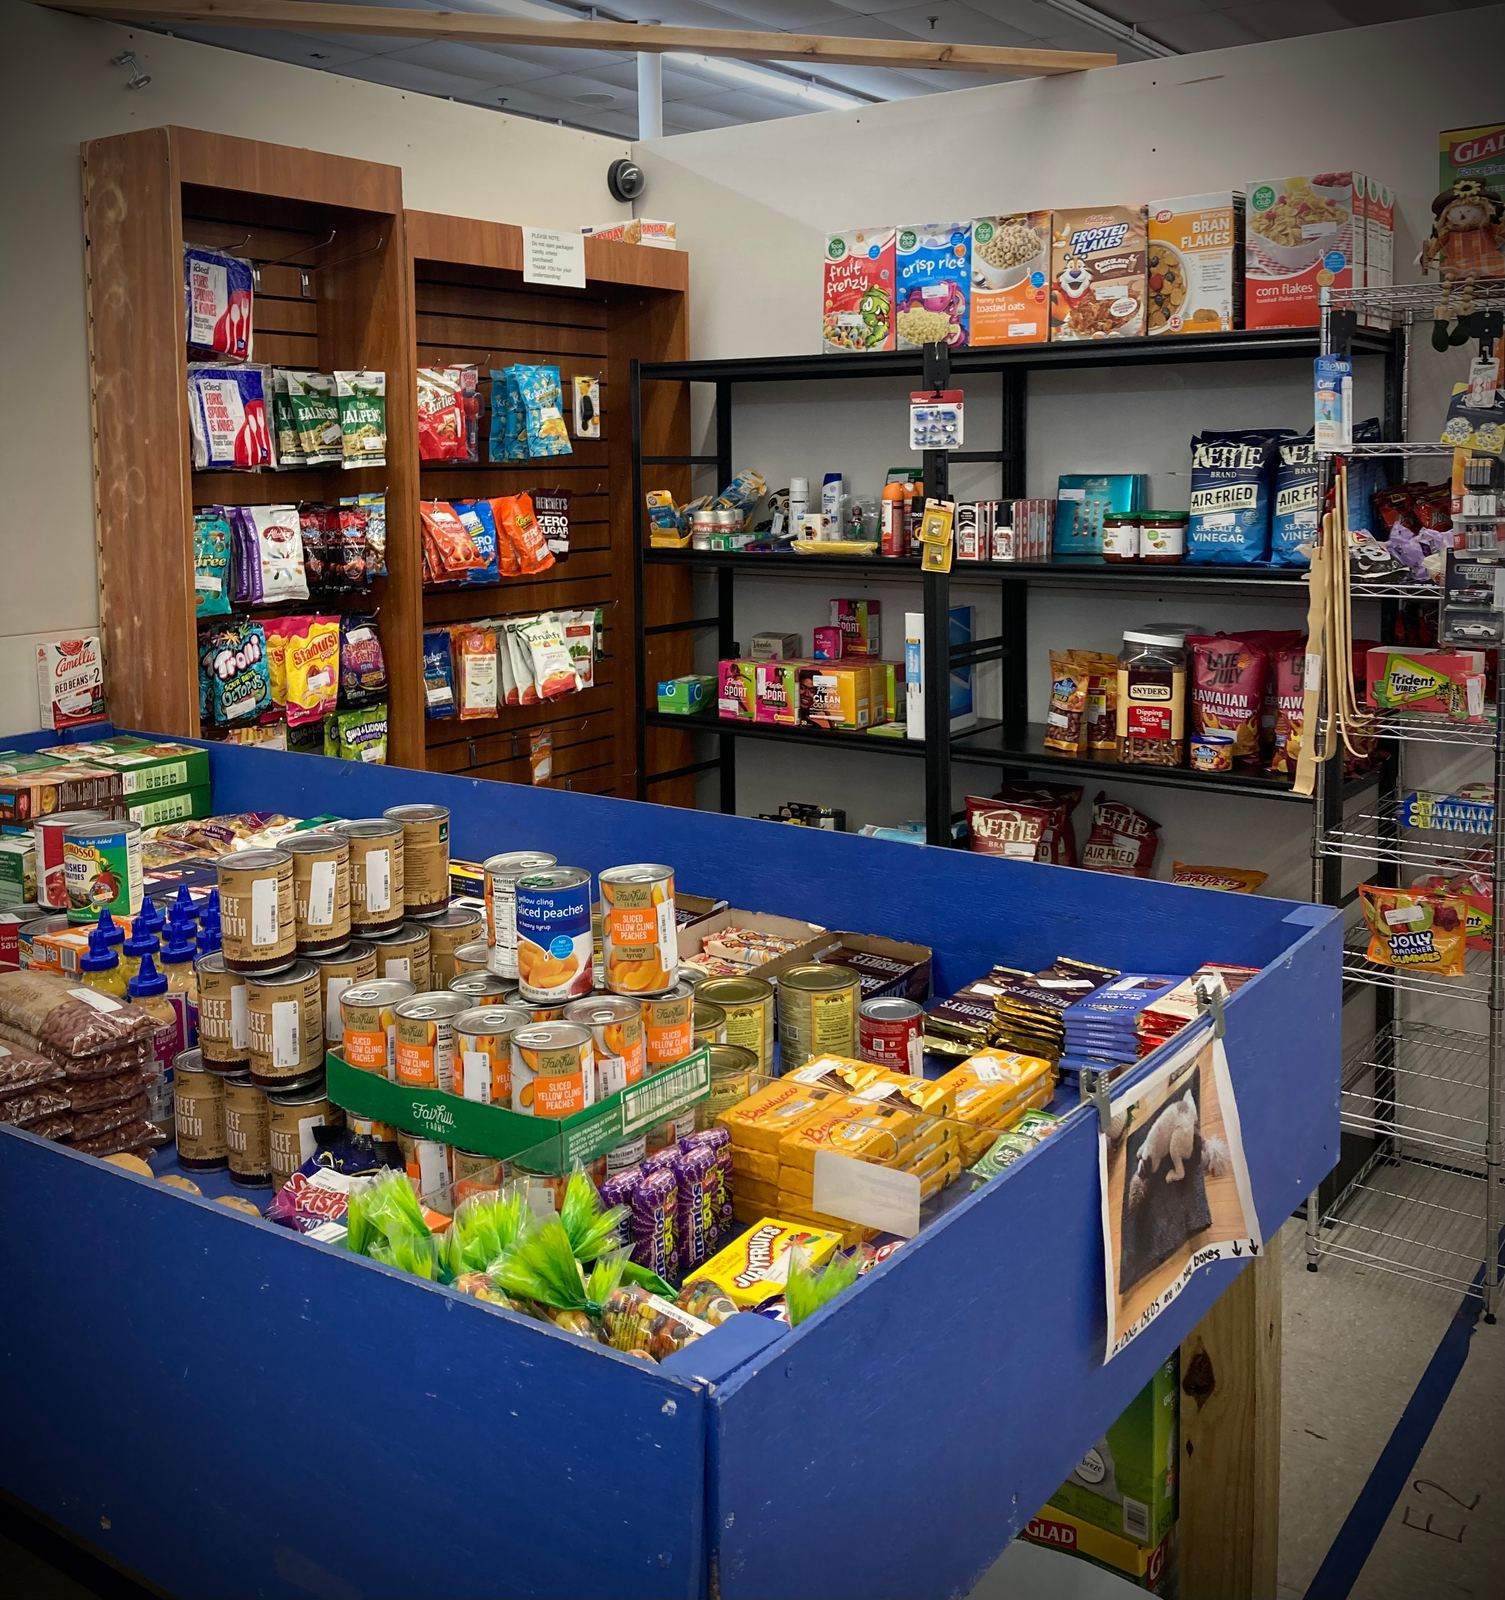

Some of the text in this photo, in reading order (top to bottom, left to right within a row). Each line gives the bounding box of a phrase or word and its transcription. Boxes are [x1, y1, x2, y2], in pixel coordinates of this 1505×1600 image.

[1072, 223, 1128, 245] FROSTED
[1192, 220, 1230, 234] BRAN
[1074, 235, 1124, 255] FLAKES
[1181, 232, 1230, 248] FLAKES
[830, 258, 861, 280] fruit
[902, 256, 966, 279] crisp rice
[193, 274, 209, 288] FORKS
[826, 275, 869, 296] frenzy
[1256, 283, 1313, 296] corn flakes
[976, 302, 1026, 312] toasted oats
[1318, 360, 1350, 372] BiteMD
[206, 392, 224, 404] FORKS
[208, 406, 228, 418] SPOONS
[217, 419, 235, 432] KNIVES
[1192, 444, 1266, 470] KETTLE
[1210, 470, 1237, 478] BRAND
[536, 496, 568, 510] HERSHEY'S
[1192, 486, 1254, 506] AIR FRIED
[1278, 490, 1301, 506] AIR
[537, 516, 568, 526] ZERO
[1192, 532, 1246, 544] VINEGAR
[213, 634, 261, 677] Trolli
[1208, 651, 1240, 670] LATE
[56, 650, 96, 677] Camellia
[55, 682, 68, 694] RED
[68, 674, 89, 688] BEANS
[94, 668, 100, 683] 2
[1206, 669, 1244, 684] JULY
[1390, 672, 1436, 688] Trident
[222, 675, 264, 706] OCTOPUS
[224, 678, 242, 692] SOUR
[724, 686, 747, 698] SPORT
[1132, 686, 1168, 696] SNYDER'S
[1395, 684, 1418, 694] VIBES
[762, 691, 786, 702] SPORT
[813, 694, 840, 704] CLEAN
[1192, 690, 1248, 706] HAWAIIAN
[1136, 708, 1164, 718] Dipping
[211, 826, 228, 836] Wide
[972, 810, 1040, 843] KETTLE
[1086, 848, 1135, 864] AIR FRIED
[518, 895, 554, 907] yellow cling
[518, 904, 584, 920] sliced peaches
[622, 914, 644, 924] SLICED
[614, 922, 654, 932] YELLOW CLING
[620, 931, 648, 940] PEACHES
[1388, 932, 1434, 948] JOLLY
[1, 942, 19, 950] sau
[632, 946, 646, 954] heavy
[1394, 946, 1433, 955] RANCHER
[1390, 952, 1440, 964] GUMMIES
[1008, 985, 1072, 1008] HERSHEY'S
[202, 998, 226, 1019] BEEF
[200, 1016, 232, 1038] BROTH
[662, 1029, 682, 1039] SLICED
[352, 1036, 372, 1046] SLICED
[652, 1039, 674, 1050] YELLOW
[364, 1045, 382, 1055] CLING
[402, 1050, 420, 1059] SLICED
[659, 1046, 684, 1057] PEACHES
[351, 1053, 376, 1062] PEACHES
[416, 1058, 430, 1069] CLING
[400, 1066, 423, 1076] PEACHES
[548, 1081, 572, 1091] SLICED
[537, 1088, 582, 1102] YELLOW CLING
[546, 1100, 574, 1110] PEACHES
[736, 1087, 798, 1122] Bauducco
[412, 1102, 457, 1128] Fairhill
[424, 1123, 446, 1134] FARMS
[295, 1189, 348, 1220] Fish
[703, 1190, 712, 1230] SOUR
[691, 1182, 704, 1260] mentos
[664, 1214, 674, 1255] SOUR
[1193, 1248, 1220, 1268] boxes
[1025, 1518, 1075, 1544] GLAD
